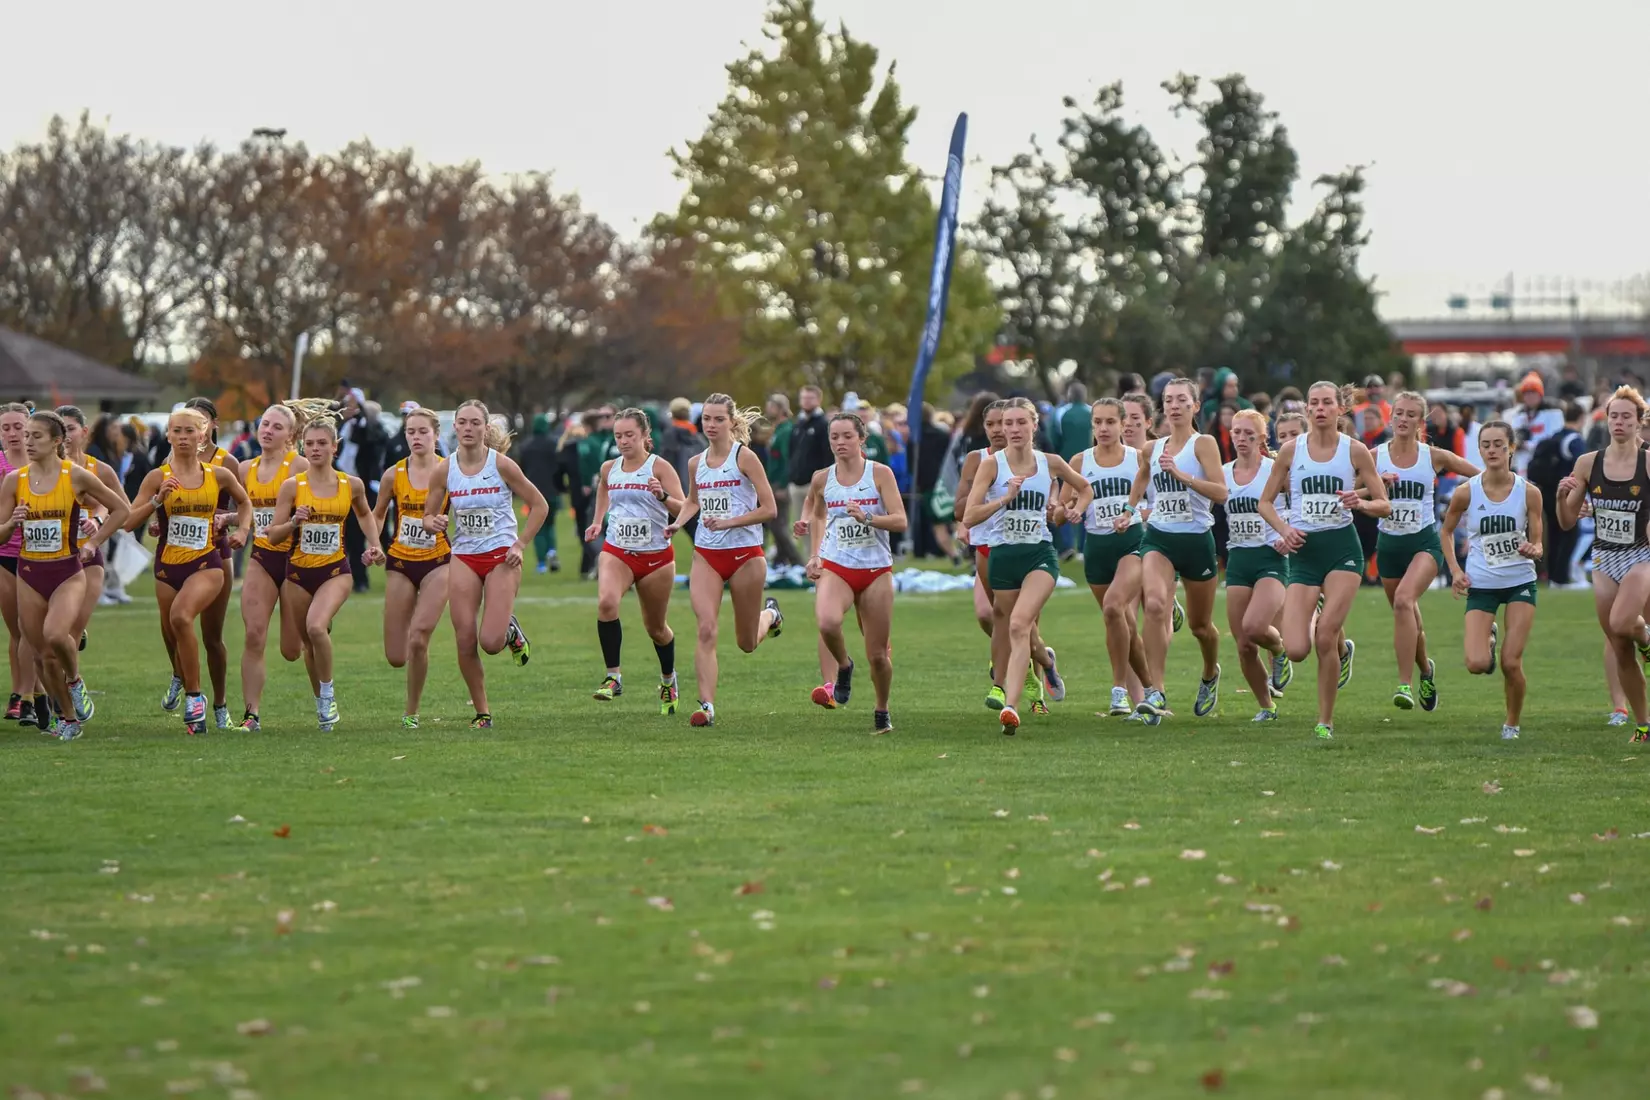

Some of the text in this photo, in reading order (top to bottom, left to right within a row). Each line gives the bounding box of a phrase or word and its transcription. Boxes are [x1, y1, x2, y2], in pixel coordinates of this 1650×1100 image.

[471, 487, 501, 495] STATE
[713, 480, 741, 488] STATE
[1091, 477, 1132, 500] OHIO
[1302, 475, 1344, 495] OHIO
[702, 497, 729, 511] 3020
[853, 498, 879, 506] TATE
[1159, 499, 1187, 512] 3178
[1306, 501, 1338, 515] 3172
[1592, 498, 1643, 511] BRONCOS
[256, 513, 274, 526] 308
[461, 514, 490, 528] 3031
[1007, 517, 1039, 532] 3167
[1480, 514, 1517, 535] OHIO
[1600, 516, 1630, 532] 3218
[27, 527, 58, 541] 3092
[173, 522, 203, 539] 3091
[618, 524, 647, 537] 3034
[839, 524, 870, 539] 3024
[1233, 520, 1261, 534] 3165
[305, 530, 336, 544] 3097
[1487, 537, 1519, 556] 3166
